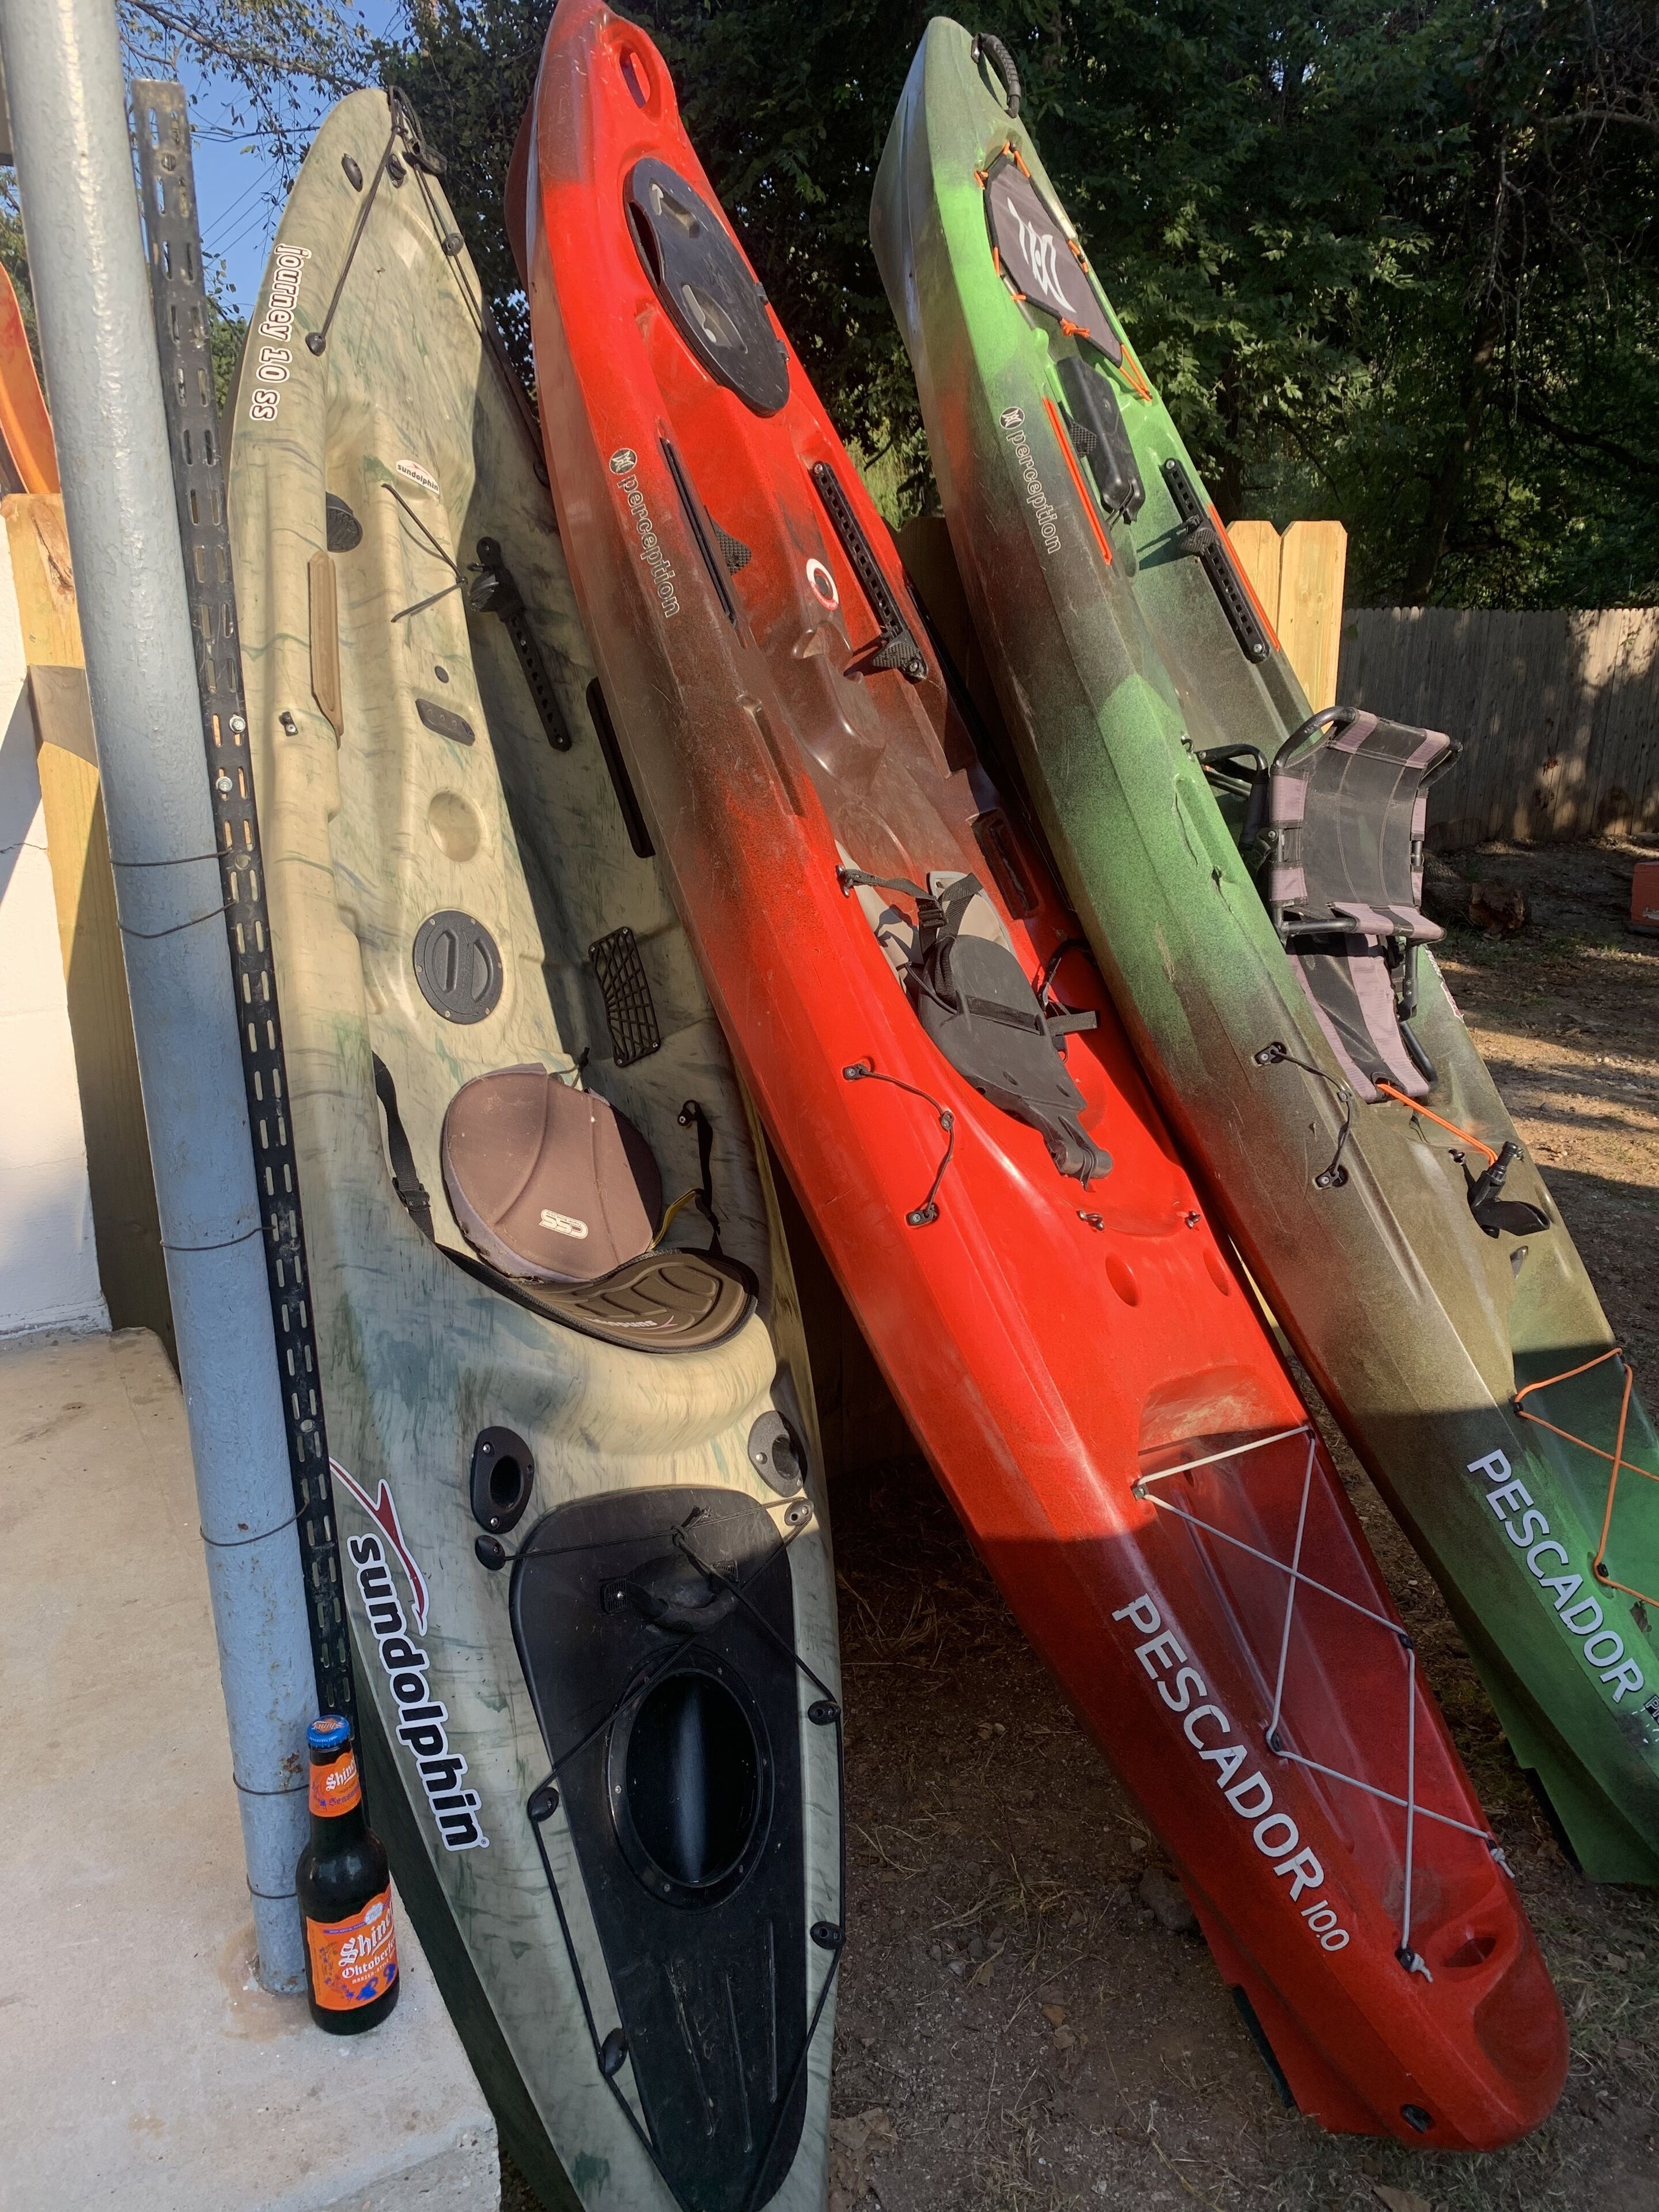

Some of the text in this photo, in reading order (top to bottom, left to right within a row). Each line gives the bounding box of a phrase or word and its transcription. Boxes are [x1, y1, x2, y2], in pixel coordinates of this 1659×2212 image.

[249, 243, 312, 421] journey 10 ss
[397, 463, 440, 491] sundolphin
[617, 474, 680, 618] perception
[1006, 430, 1062, 555] perception
[1467, 1448, 1645, 1703] PESCADOR
[348, 1534, 480, 1848] sundolphin
[1112, 1593, 1324, 1902] PESCADOR
